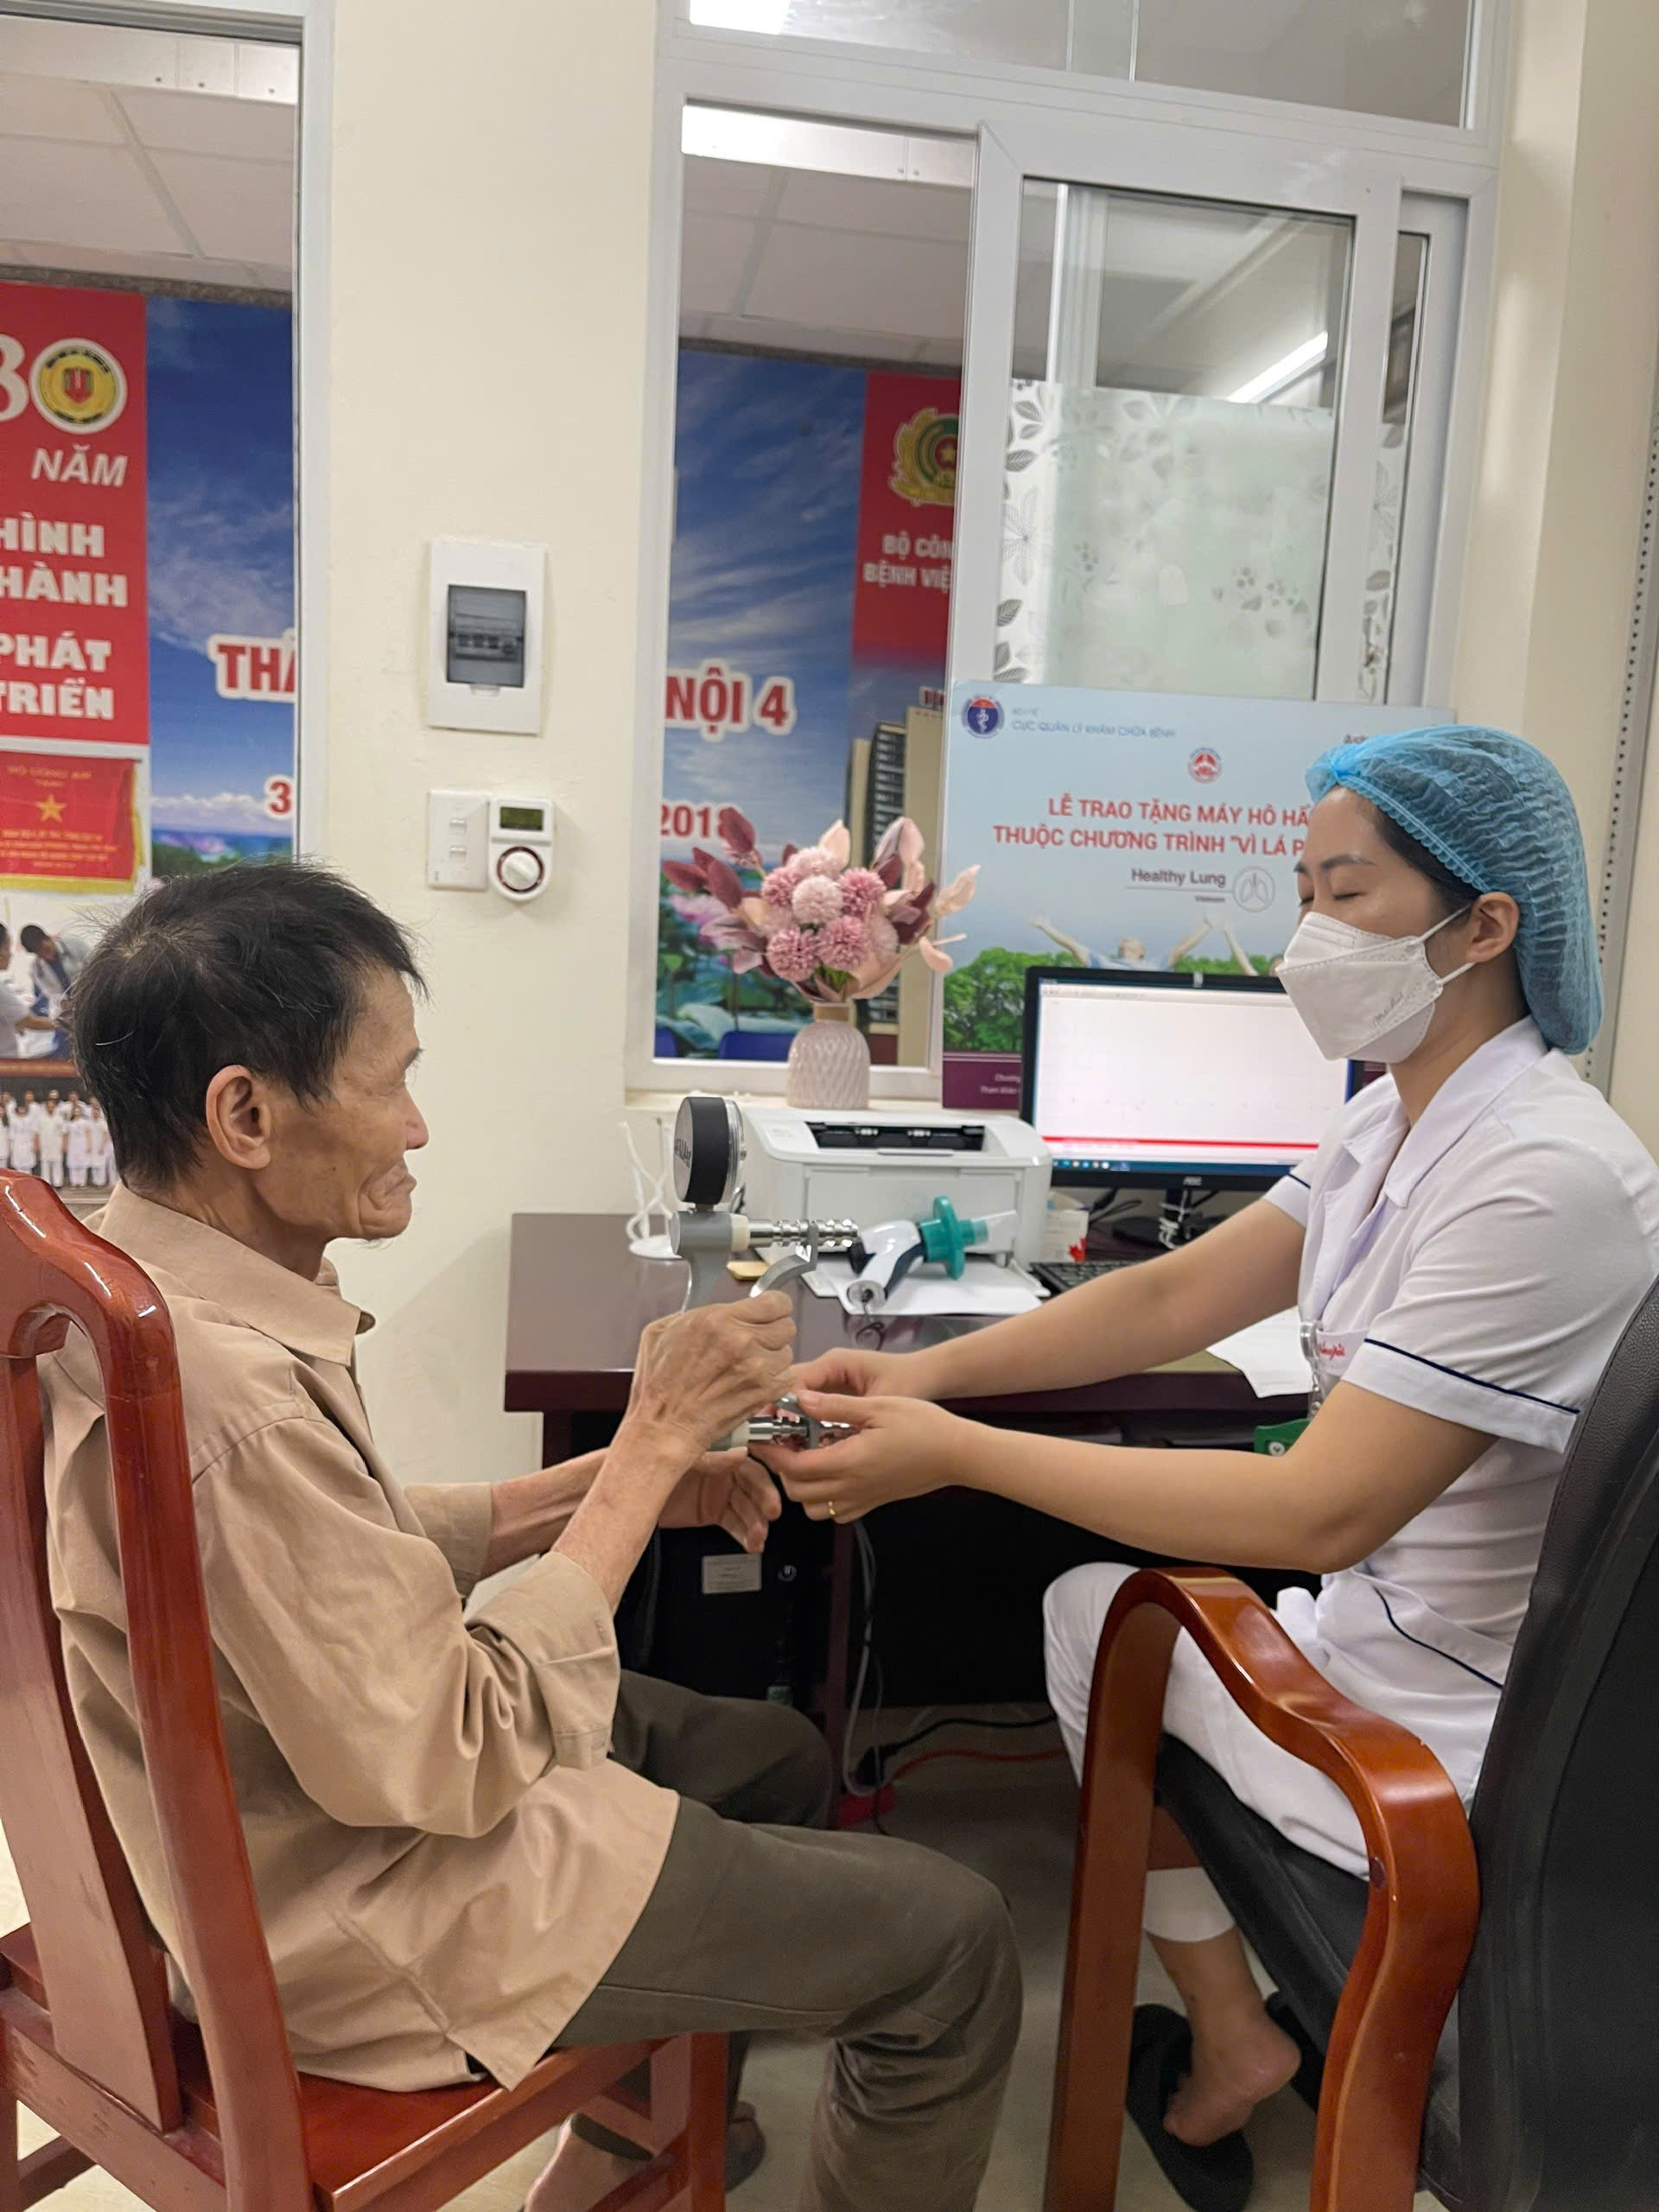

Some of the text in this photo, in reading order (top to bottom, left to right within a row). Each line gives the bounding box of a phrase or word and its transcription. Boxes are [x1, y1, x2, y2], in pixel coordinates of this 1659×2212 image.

[31, 443, 128, 487] NĂM
[883, 531, 910, 560] BỘ
[863, 561, 917, 588] BỆNH
[665, 666, 788, 734] NỘI 4
[1048, 792, 1072, 817] LỄ
[1078, 798, 1133, 820] TRAO
[1139, 798, 1192, 823] TẶNG
[1198, 803, 1243, 823] MÁY
[1249, 804, 1276, 826] HÔ
[993, 823, 1064, 849] THUỘC
[1070, 829, 1158, 850] CHƯƠNG
[1163, 830, 1225, 854] TRÌNH
[1262, 835, 1287, 856] LÁ
[1130, 868, 1226, 887] Healthy Lung
